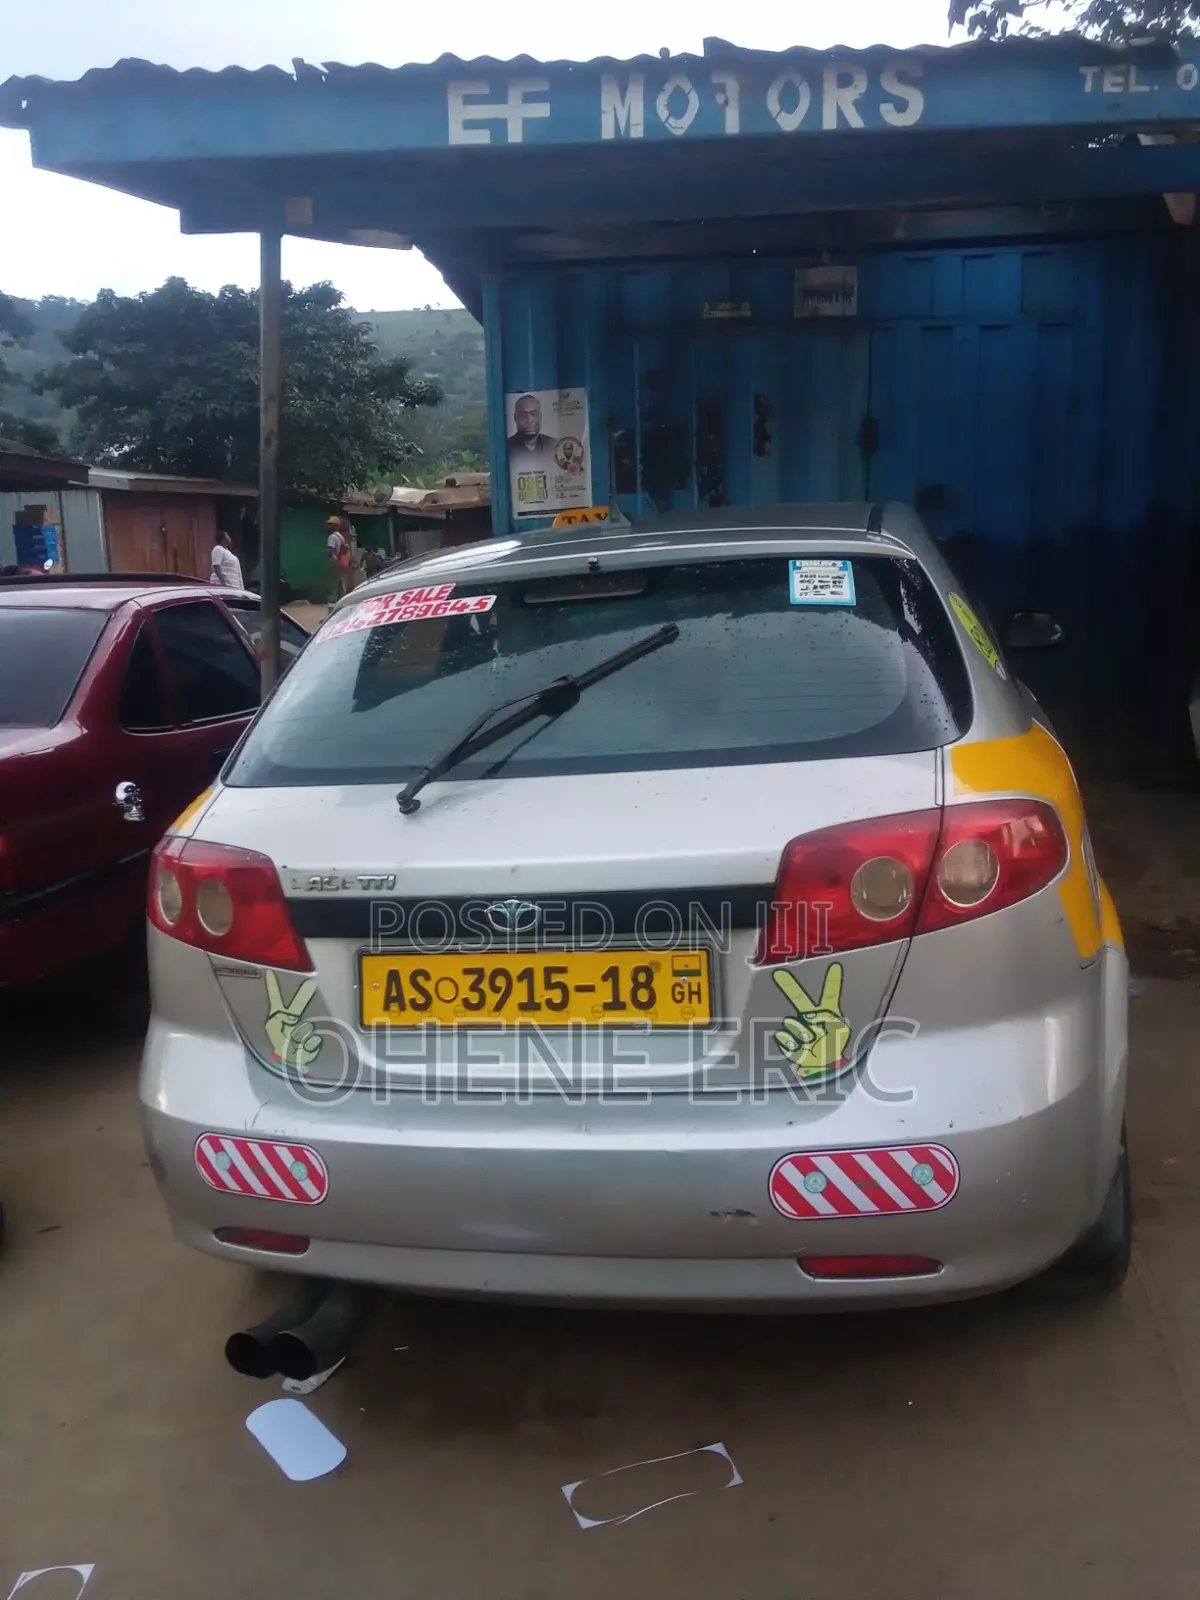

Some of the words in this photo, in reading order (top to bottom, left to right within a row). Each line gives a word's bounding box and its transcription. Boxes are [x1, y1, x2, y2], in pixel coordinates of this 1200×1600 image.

[1079, 64, 1159, 93] TEL.
[601, 60, 925, 140] MOTORS
[396, 583, 451, 607] SALE
[383, 968, 433, 1013] AS
[671, 982, 702, 1005] GH
